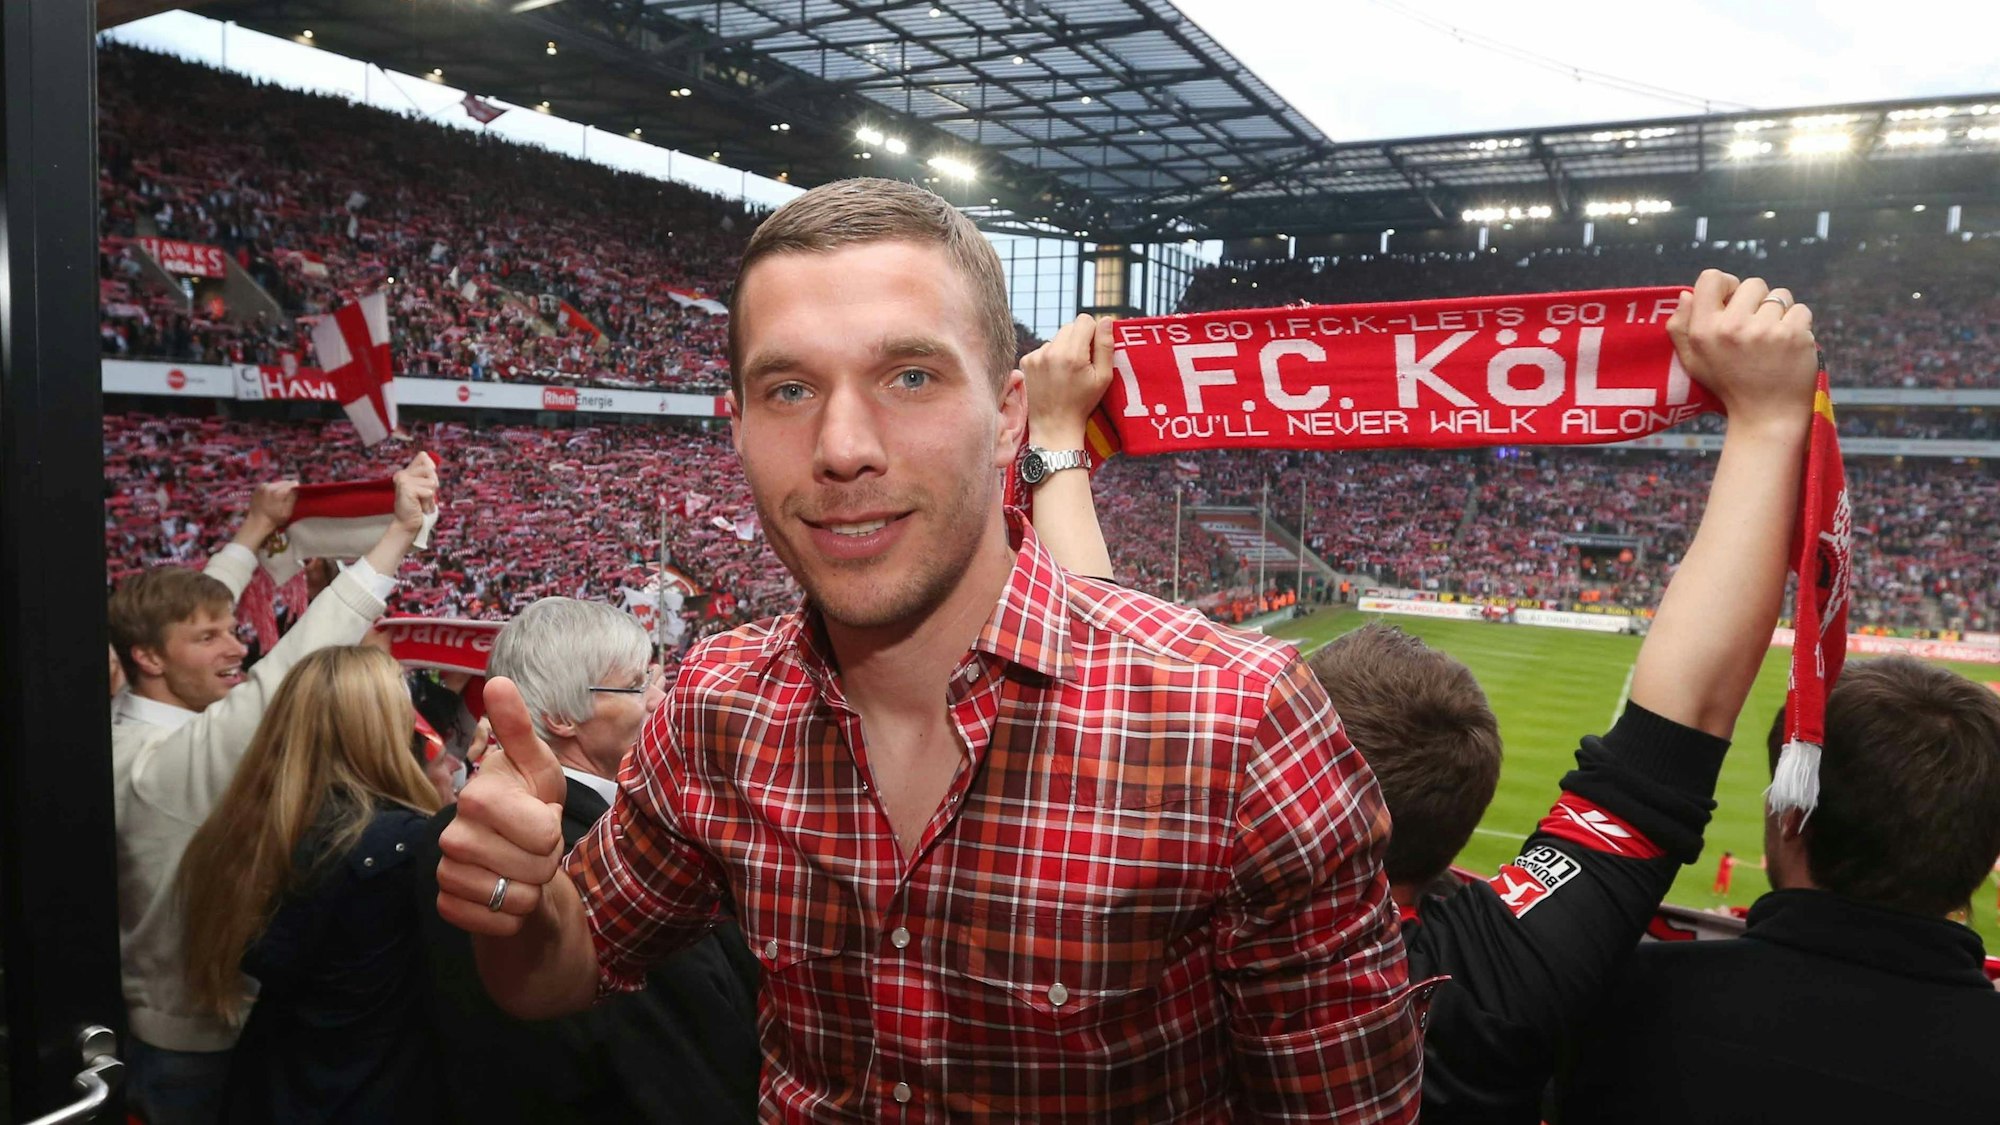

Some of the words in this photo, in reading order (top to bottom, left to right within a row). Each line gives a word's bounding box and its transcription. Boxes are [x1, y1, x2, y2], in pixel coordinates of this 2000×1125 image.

[1204, 320, 1254, 341] GO
[1546, 302, 1606, 325] GO
[1113, 338, 1354, 417] 1.F.C.
[1151, 414, 1269, 439] YOU'LL
[1286, 410, 1409, 436] NEVER
[1430, 408, 1538, 434] WALK
[1561, 401, 1702, 434] ALONE
